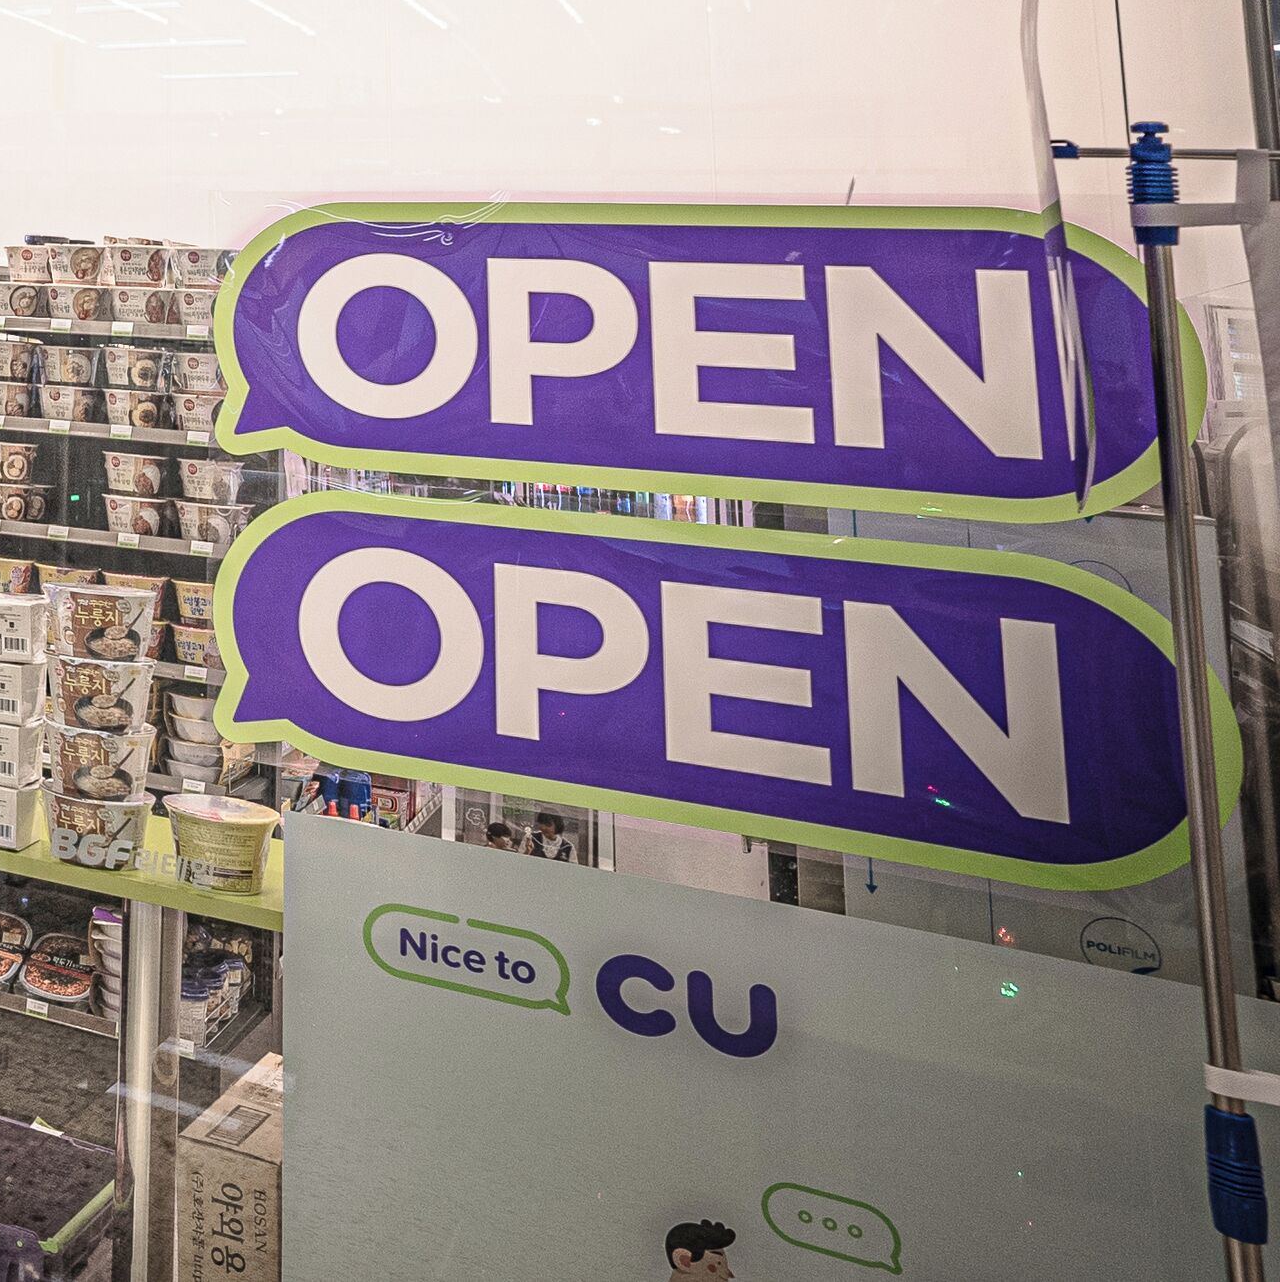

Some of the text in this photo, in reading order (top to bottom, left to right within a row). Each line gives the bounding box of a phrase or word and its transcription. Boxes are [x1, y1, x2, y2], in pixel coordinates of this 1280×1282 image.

[297, 252, 1043, 461] OPEN
[75, 607, 119, 626] 누룽지
[64, 673, 107, 694] 누룽지
[298, 547, 1070, 825] OPEN
[59, 810, 101, 834] 누룽지
[398, 927, 537, 986] Nice to
[1086, 940, 1156, 960] POLIFILM
[595, 953, 779, 1059] CU
[211, 1182, 246, 1274] 야외용
[252, 1188, 268, 1253] HOSAN
